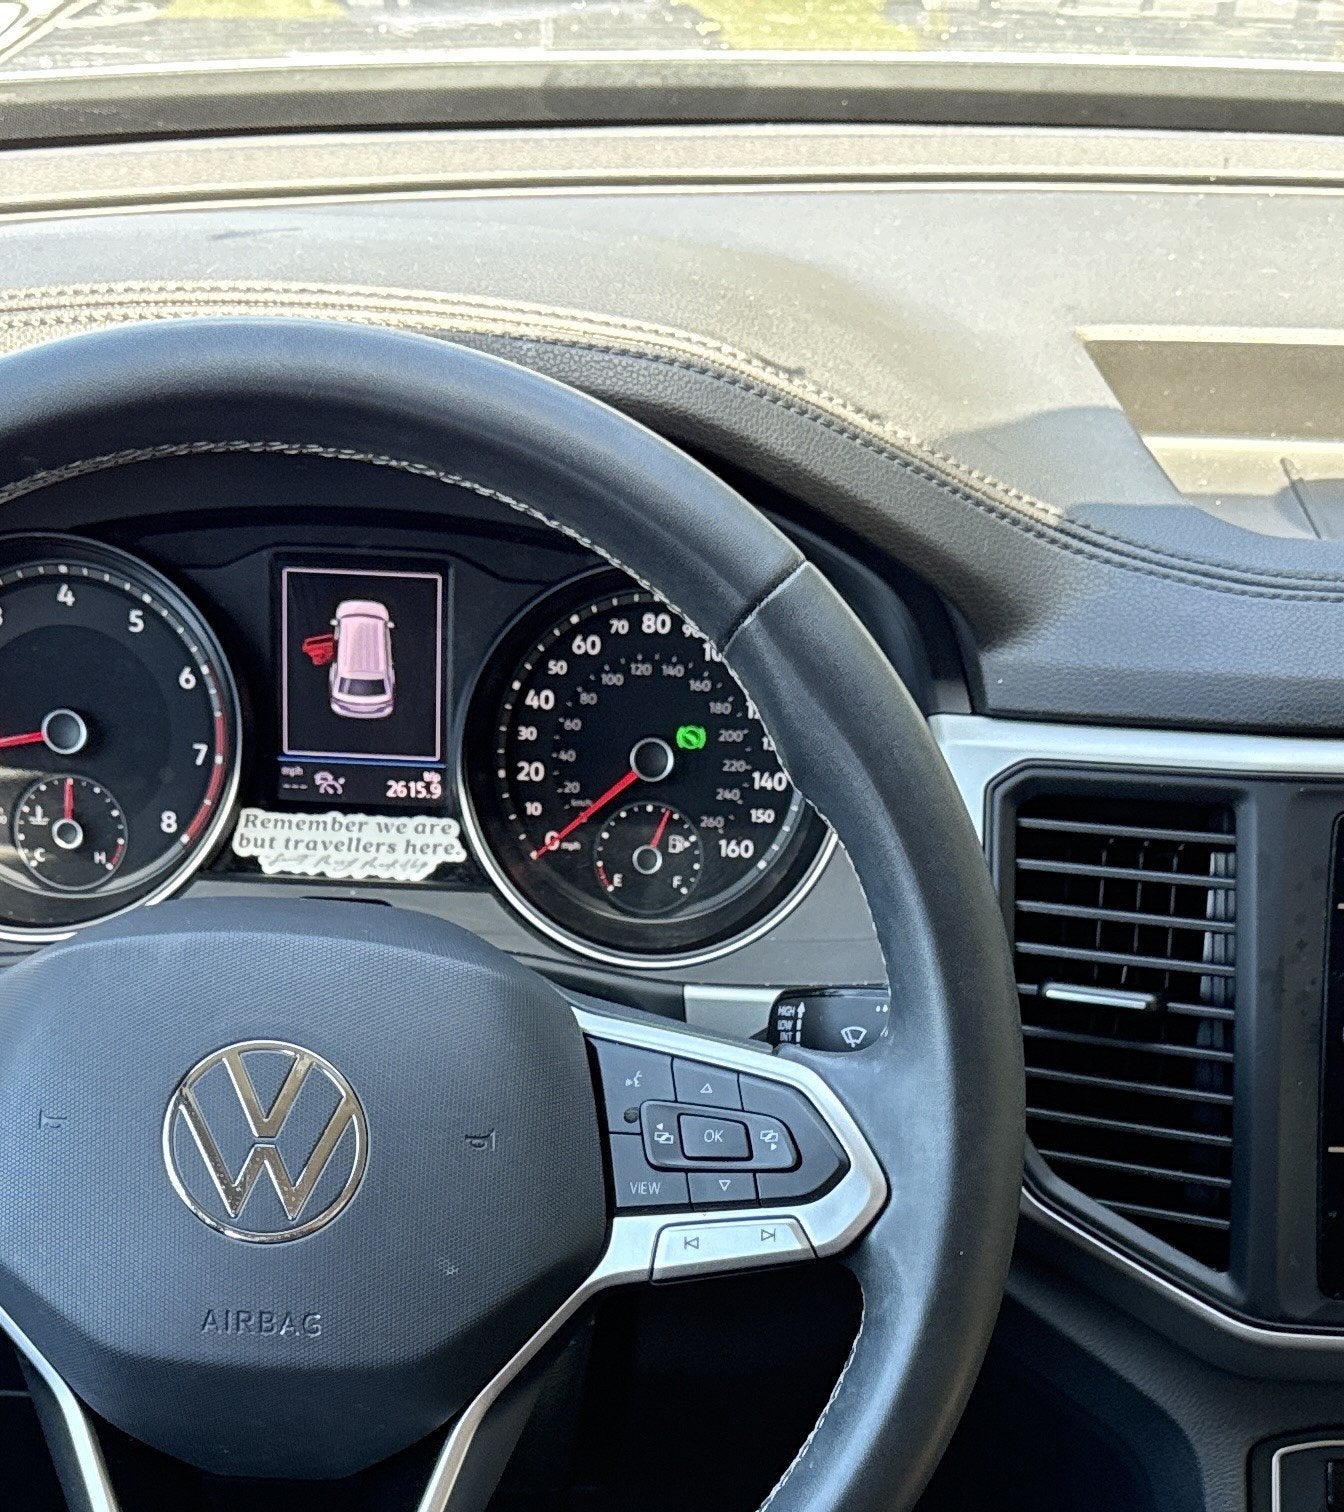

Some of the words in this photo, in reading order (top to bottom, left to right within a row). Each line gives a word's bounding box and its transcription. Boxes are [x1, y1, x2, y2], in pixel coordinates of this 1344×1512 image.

[57, 584, 75, 606] 4
[128, 609, 144, 633] 5
[609, 618, 629, 635] 70
[641, 612, 671, 635] 80
[572, 634, 601, 655] 60
[179, 666, 196, 689] 6
[547, 660, 567, 675] 50
[630, 662, 652, 676] 120
[689, 679, 712, 692] 160
[525, 688, 555, 710] 40
[517, 726, 537, 741] 30
[193, 743, 208, 766] 7
[516, 761, 544, 781] 20
[752, 771, 787, 791] 140
[386, 779, 441, 799] 2615.9
[525, 802, 542, 816] 10
[750, 809, 775, 823] 150
[160, 810, 178, 834] 8
[243, 813, 368, 832] Remember
[376, 820, 407, 834] we
[414, 821, 452, 835] are
[238, 833, 276, 849] but
[284, 836, 397, 855] travellers
[405, 838, 461, 856] here.
[718, 839, 754, 859] 160
[33, 847, 45, 863] C
[94, 851, 106, 866] H
[613, 873, 623, 888] E
[672, 875, 682, 889] F
[704, 1130, 723, 1144] OK
[629, 1181, 661, 1195] VIEW
[201, 1309, 322, 1337] AIRBAG
